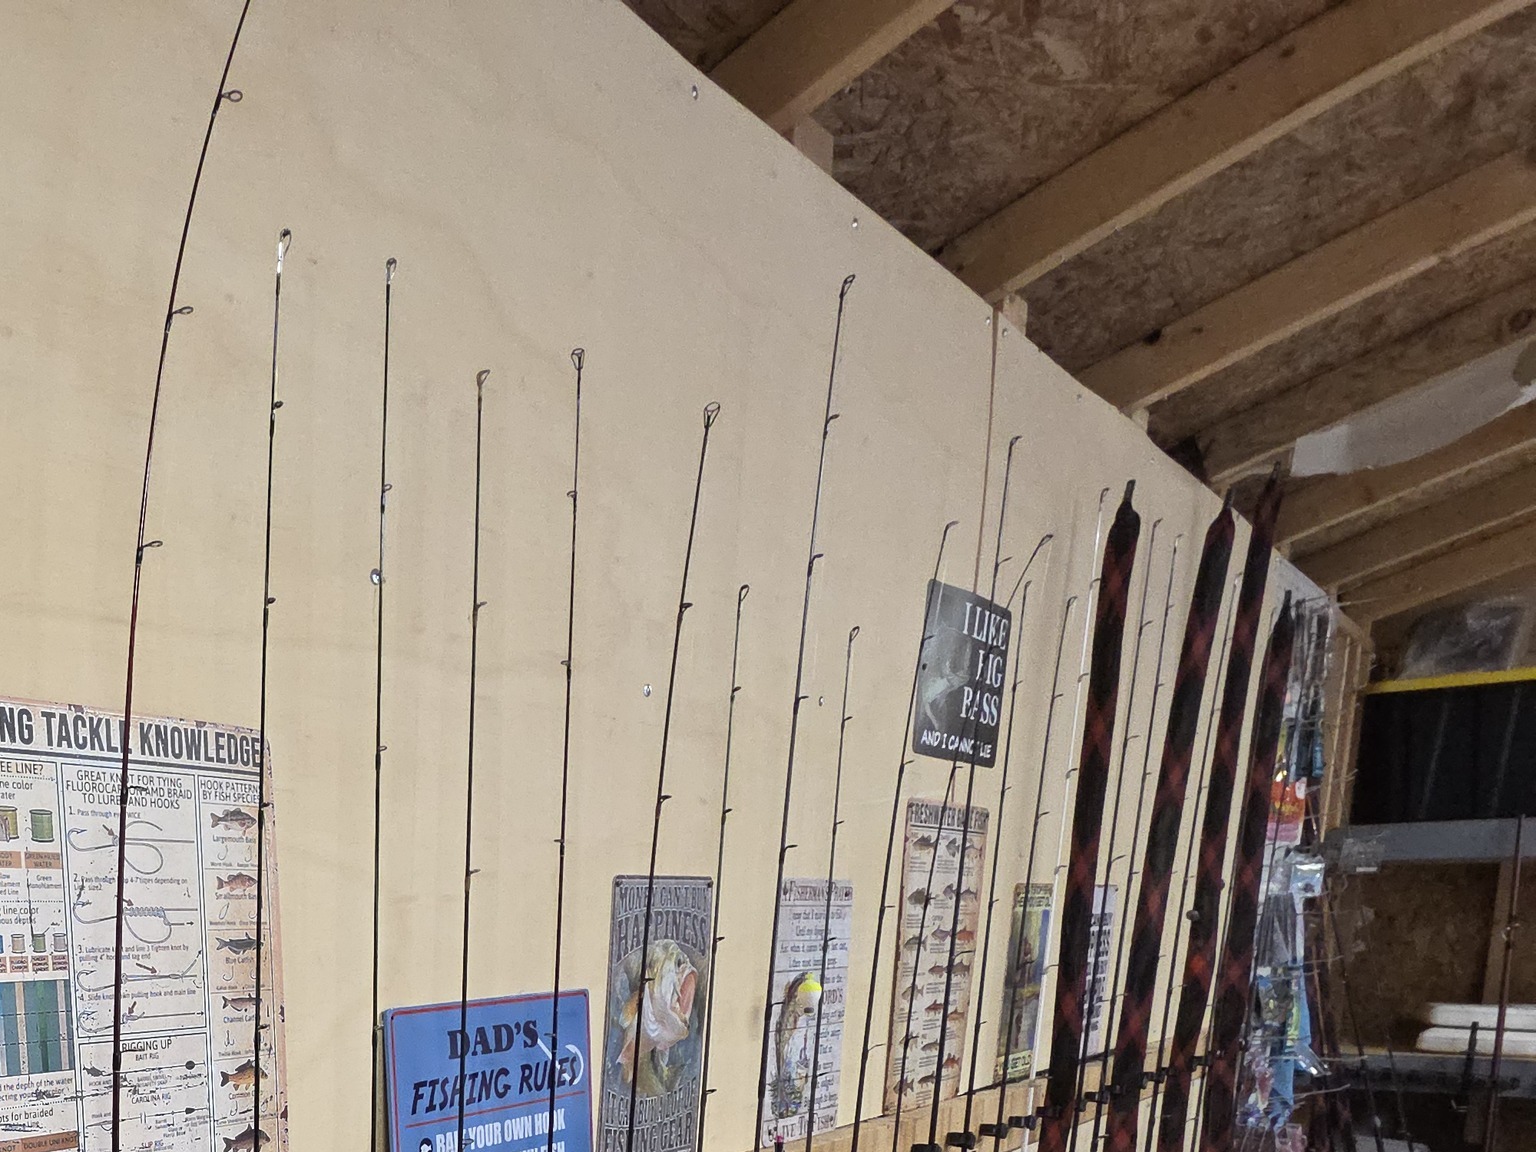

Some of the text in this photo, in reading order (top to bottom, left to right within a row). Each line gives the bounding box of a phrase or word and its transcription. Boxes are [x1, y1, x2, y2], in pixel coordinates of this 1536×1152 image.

[973, 606, 1009, 650] LIKE
[139, 722, 260, 768] KNOWLEDGE
[921, 729, 941, 747] AND
[15, 763, 44, 775] LINE?
[12, 780, 33, 790] color
[76, 770, 182, 788] GREAT FOR TYING
[200, 779, 224, 790] HOOK
[167, 788, 192, 799] BRAID
[202, 791, 232, 801] BY FISH
[83, 793, 180, 809] TO AND HOOKS
[3, 906, 18, 914] line
[19, 907, 39, 915] color
[122, 1038, 172, 1051] RIGGING UP
[447, 1020, 538, 1059] DAD'S
[3, 1083, 14, 1091] the
[15, 1082, 35, 1090] depth
[44, 1079, 54, 1087] the
[55, 1077, 73, 1085] water
[410, 1067, 512, 1116] FISHING
[132, 1094, 161, 1105] CAROLINA
[11, 1112, 23, 1121] for
[24, 1108, 54, 1120] braided
[469, 1122, 502, 1149] YOUR
[504, 1115, 532, 1142] OWN
[660, 1111, 692, 1150] GEAR
